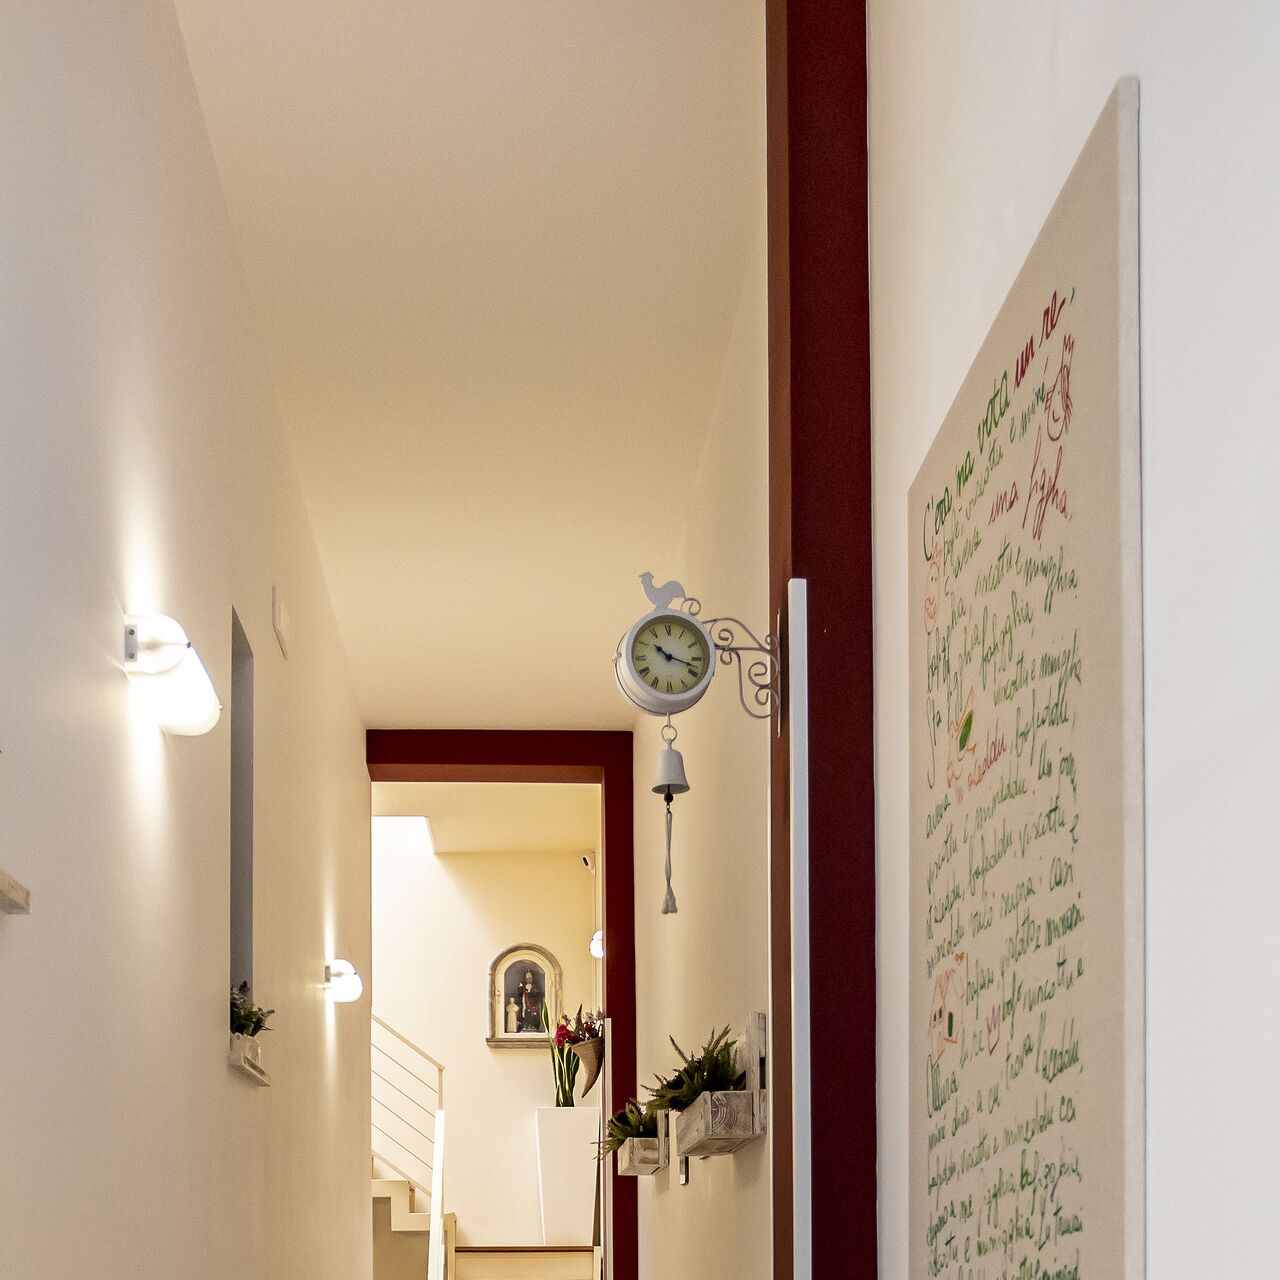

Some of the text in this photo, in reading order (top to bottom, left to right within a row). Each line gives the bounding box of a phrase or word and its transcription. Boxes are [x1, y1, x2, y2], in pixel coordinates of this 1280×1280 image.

[975, 368, 1011, 456] vota
[1012, 333, 1035, 392] un
[987, 479, 1019, 526] una
